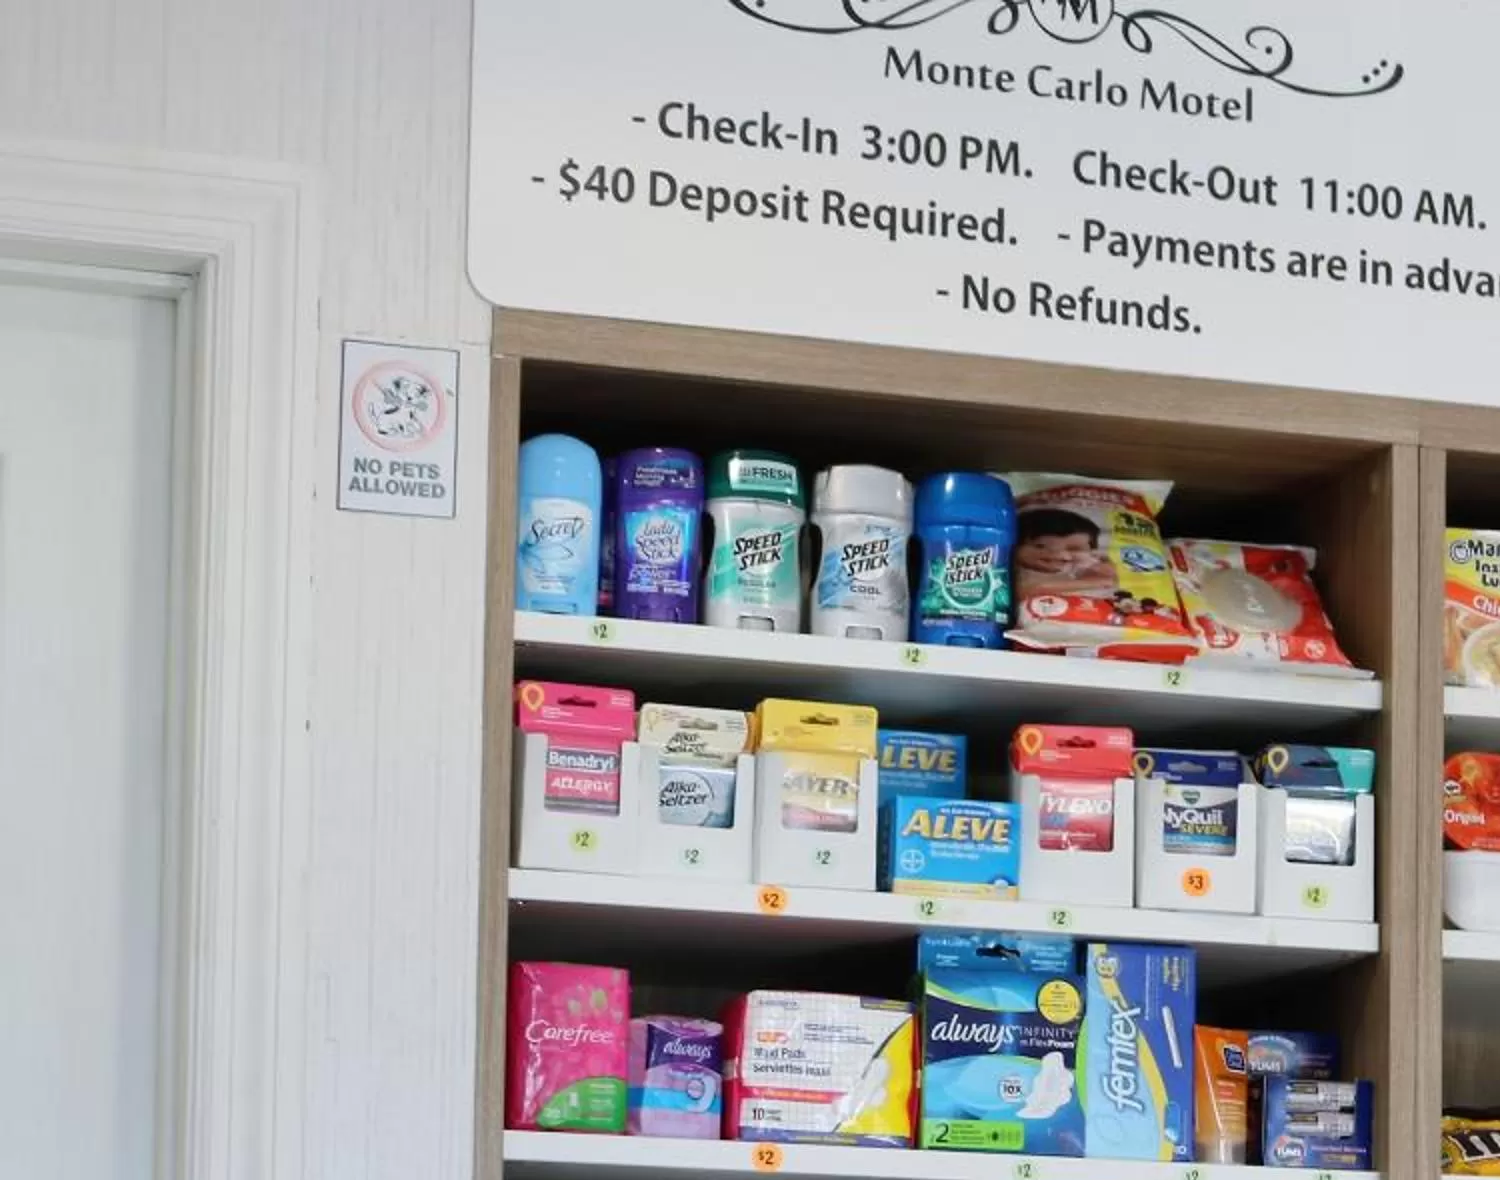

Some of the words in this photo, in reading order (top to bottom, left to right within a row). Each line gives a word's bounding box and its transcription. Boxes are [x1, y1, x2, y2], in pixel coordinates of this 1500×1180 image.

[884, 45, 1016, 94] Monte
[1027, 65, 1128, 108] Carlo
[1140, 78, 1255, 123] Motel
[656, 101, 839, 157] Check-In
[861, 124, 947, 168] 3:00
[959, 135, 1034, 180] PM.
[1073, 149, 1278, 207] Check-Out
[1299, 174, 1404, 222] 11:00
[1413, 189, 1488, 233] AM.
[558, 159, 636, 205] $40
[648, 170, 810, 224] Deposit
[821, 189, 1019, 247] Required.
[1082, 218, 1276, 277] Payments
[1286, 250, 1348, 284] are
[1359, 251, 1395, 290] in
[961, 275, 1017, 316] No
[1028, 281, 1202, 335] Refunds.
[353, 456, 382, 475] NO
[389, 461, 441, 480] PETS
[752, 466, 793, 481] FRESH
[348, 477, 446, 499] ALLOWED
[529, 515, 584, 541] Secret
[734, 532, 782, 556] SPEED
[841, 538, 890, 564] SPEED
[739, 549, 782, 571] STICK
[847, 553, 890, 577] STICK
[946, 548, 992, 572] SPEED
[947, 568, 985, 585] STICK
[849, 584, 881, 595] COOL
[549, 751, 615, 771] Benadryl
[550, 775, 614, 794] ALLERGY
[659, 792, 709, 807] Seltzer
[1039, 792, 1113, 815] TYLENO
[902, 808, 1011, 844] ALEVE
[575, 831, 591, 848] $2
[1187, 872, 1205, 891] $3
[525, 1019, 615, 1046] Carefree
[931, 1014, 1013, 1052] always
[662, 1036, 714, 1060] always
[758, 1149, 775, 1166] $2
